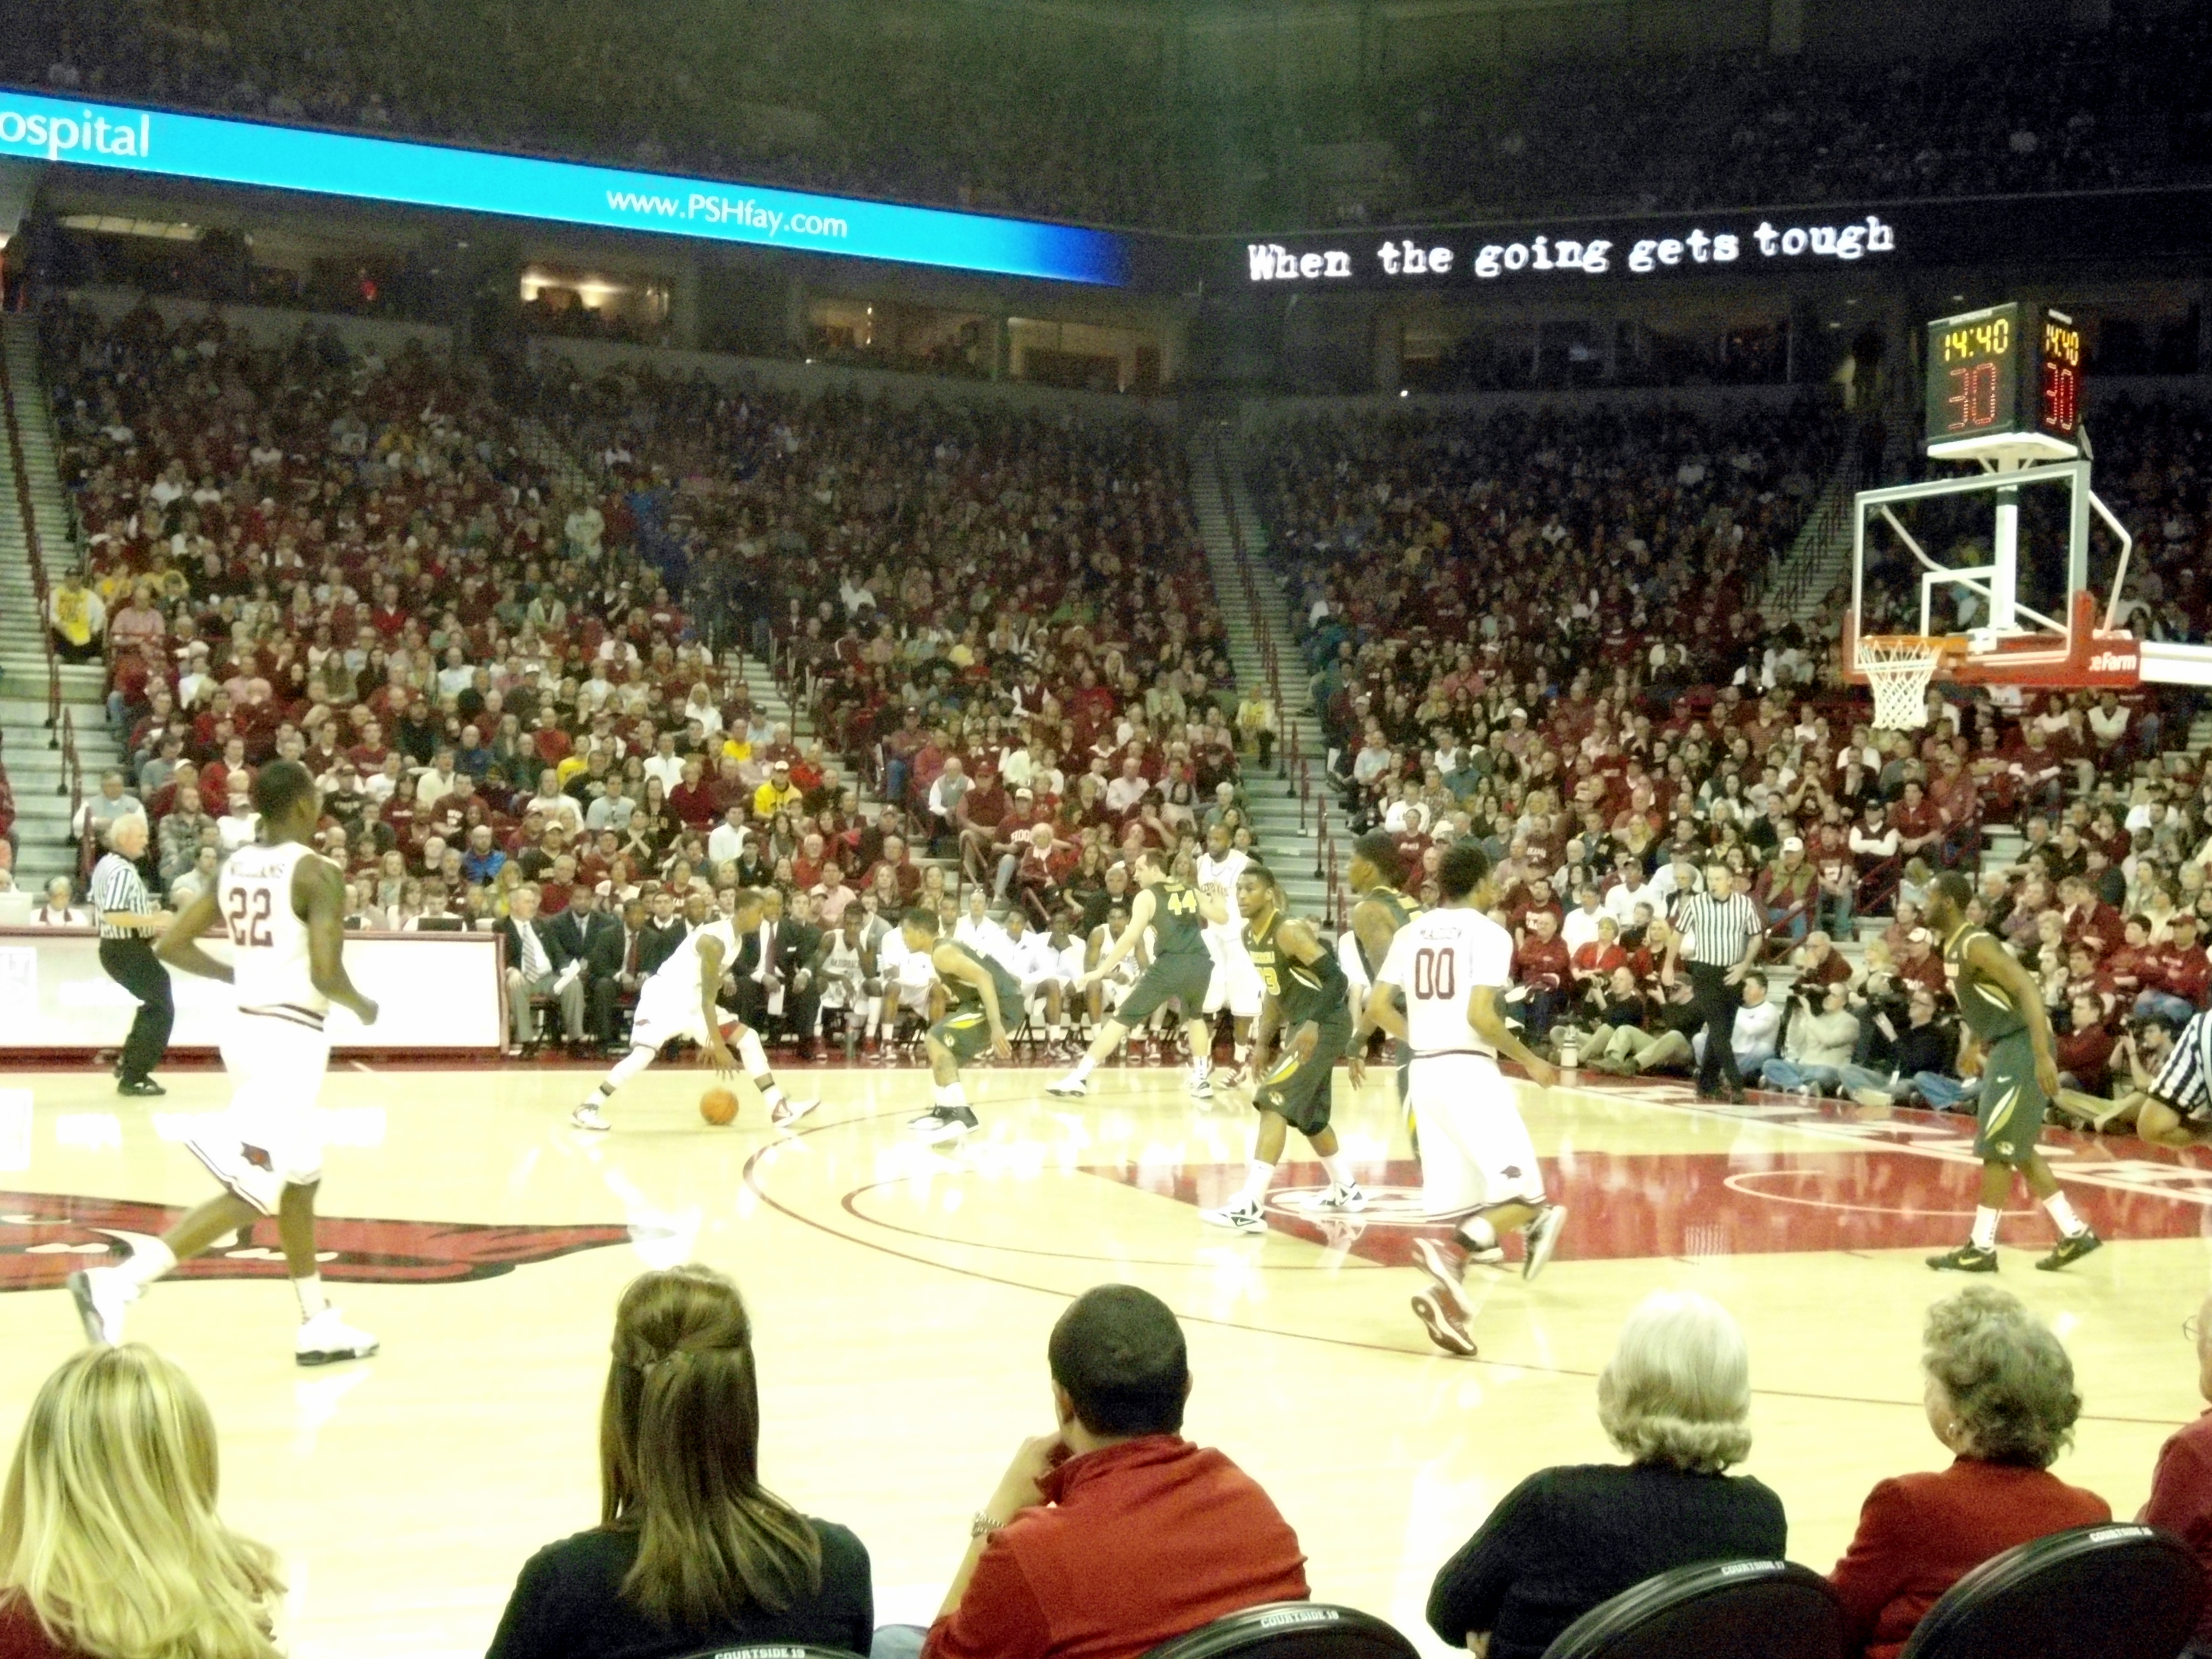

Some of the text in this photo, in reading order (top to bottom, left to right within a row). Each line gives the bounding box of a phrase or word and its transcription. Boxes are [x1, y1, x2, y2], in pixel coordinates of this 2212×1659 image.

[606, 190, 848, 238] www.PSHfay.com
[1248, 216, 1895, 280] When the going gets tough
[1945, 319, 2008, 361] 14:40
[1948, 363, 1996, 429] 30
[2047, 362, 2073, 430] 30
[2089, 651, 2137, 671] eFarm
[229, 887, 274, 947] 22
[1168, 890, 1197, 915] 44
[1415, 948, 1455, 1000] 00
[1260, 1610, 1326, 1628] COURTSIDE
[714, 1647, 790, 1659] COURTSIDE
